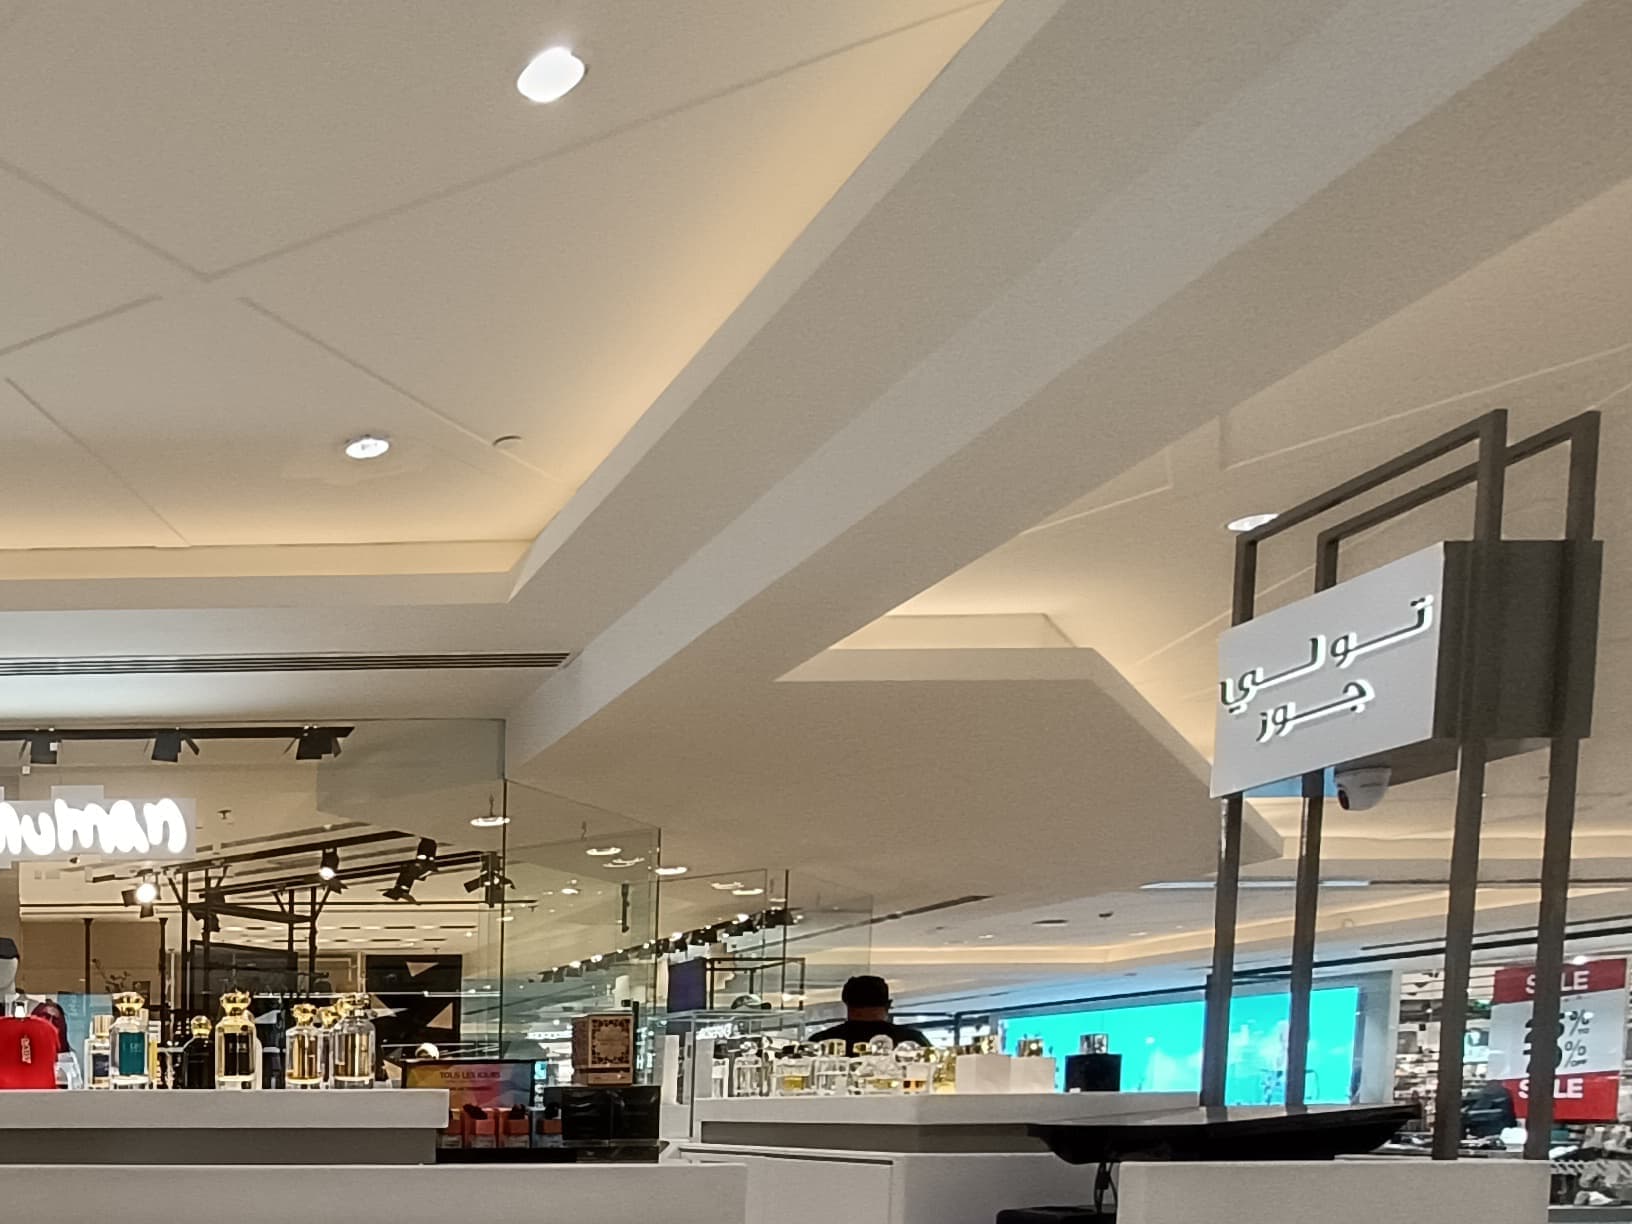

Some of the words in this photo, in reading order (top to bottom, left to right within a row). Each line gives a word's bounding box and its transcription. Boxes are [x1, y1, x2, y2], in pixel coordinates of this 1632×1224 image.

[1255, 678, 1376, 743] جوز
[1525, 970, 1590, 994] SLE
[1518, 1077, 1584, 1099] SLE
